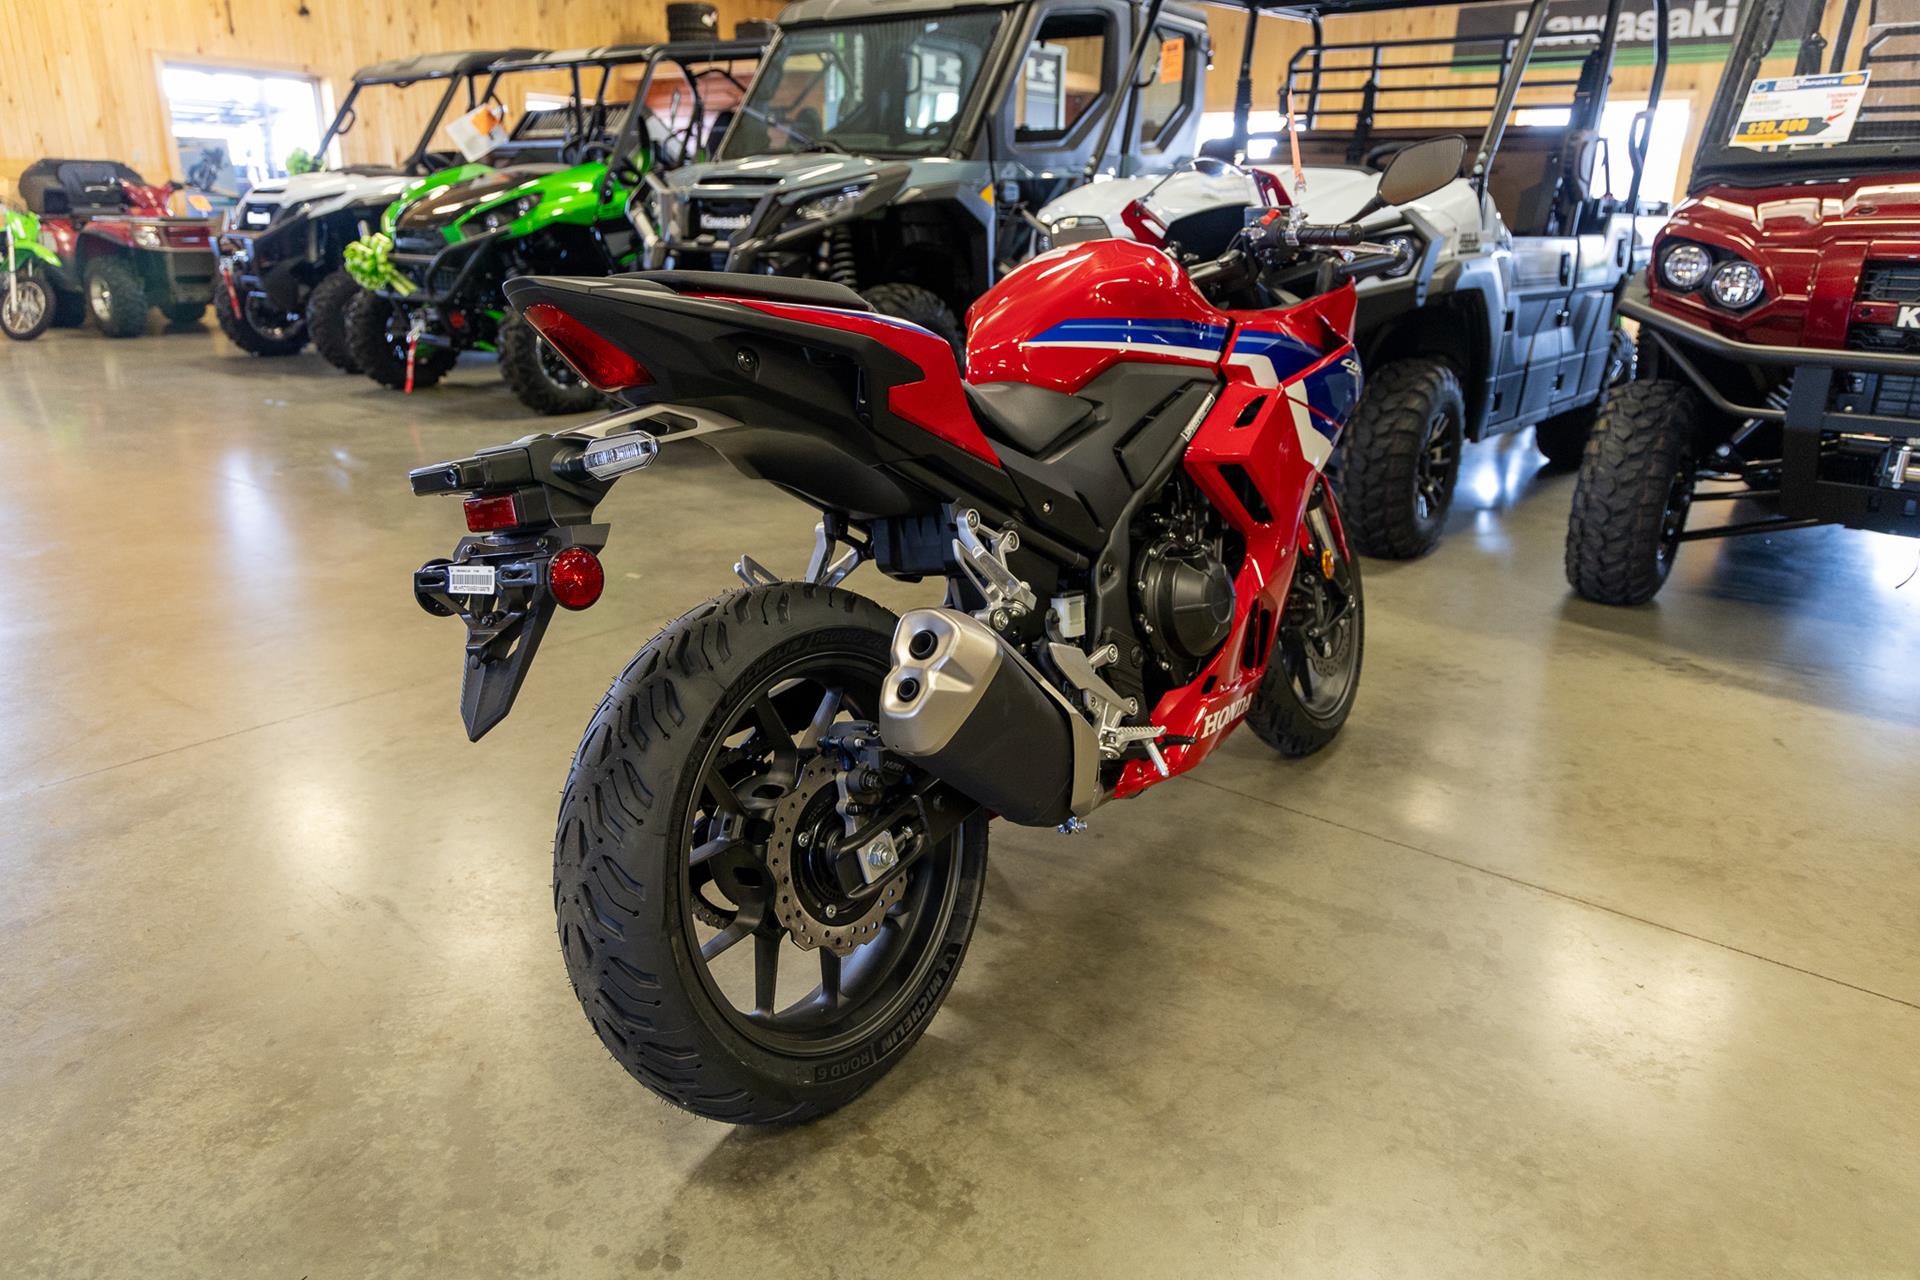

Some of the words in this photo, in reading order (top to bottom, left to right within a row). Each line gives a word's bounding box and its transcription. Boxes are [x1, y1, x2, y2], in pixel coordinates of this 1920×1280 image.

[700, 213, 752, 230] Kawasak
[1200, 693, 1253, 739] HONDA
[881, 970, 943, 1054] MICHELIN
[831, 1050, 869, 1078] ROAD
